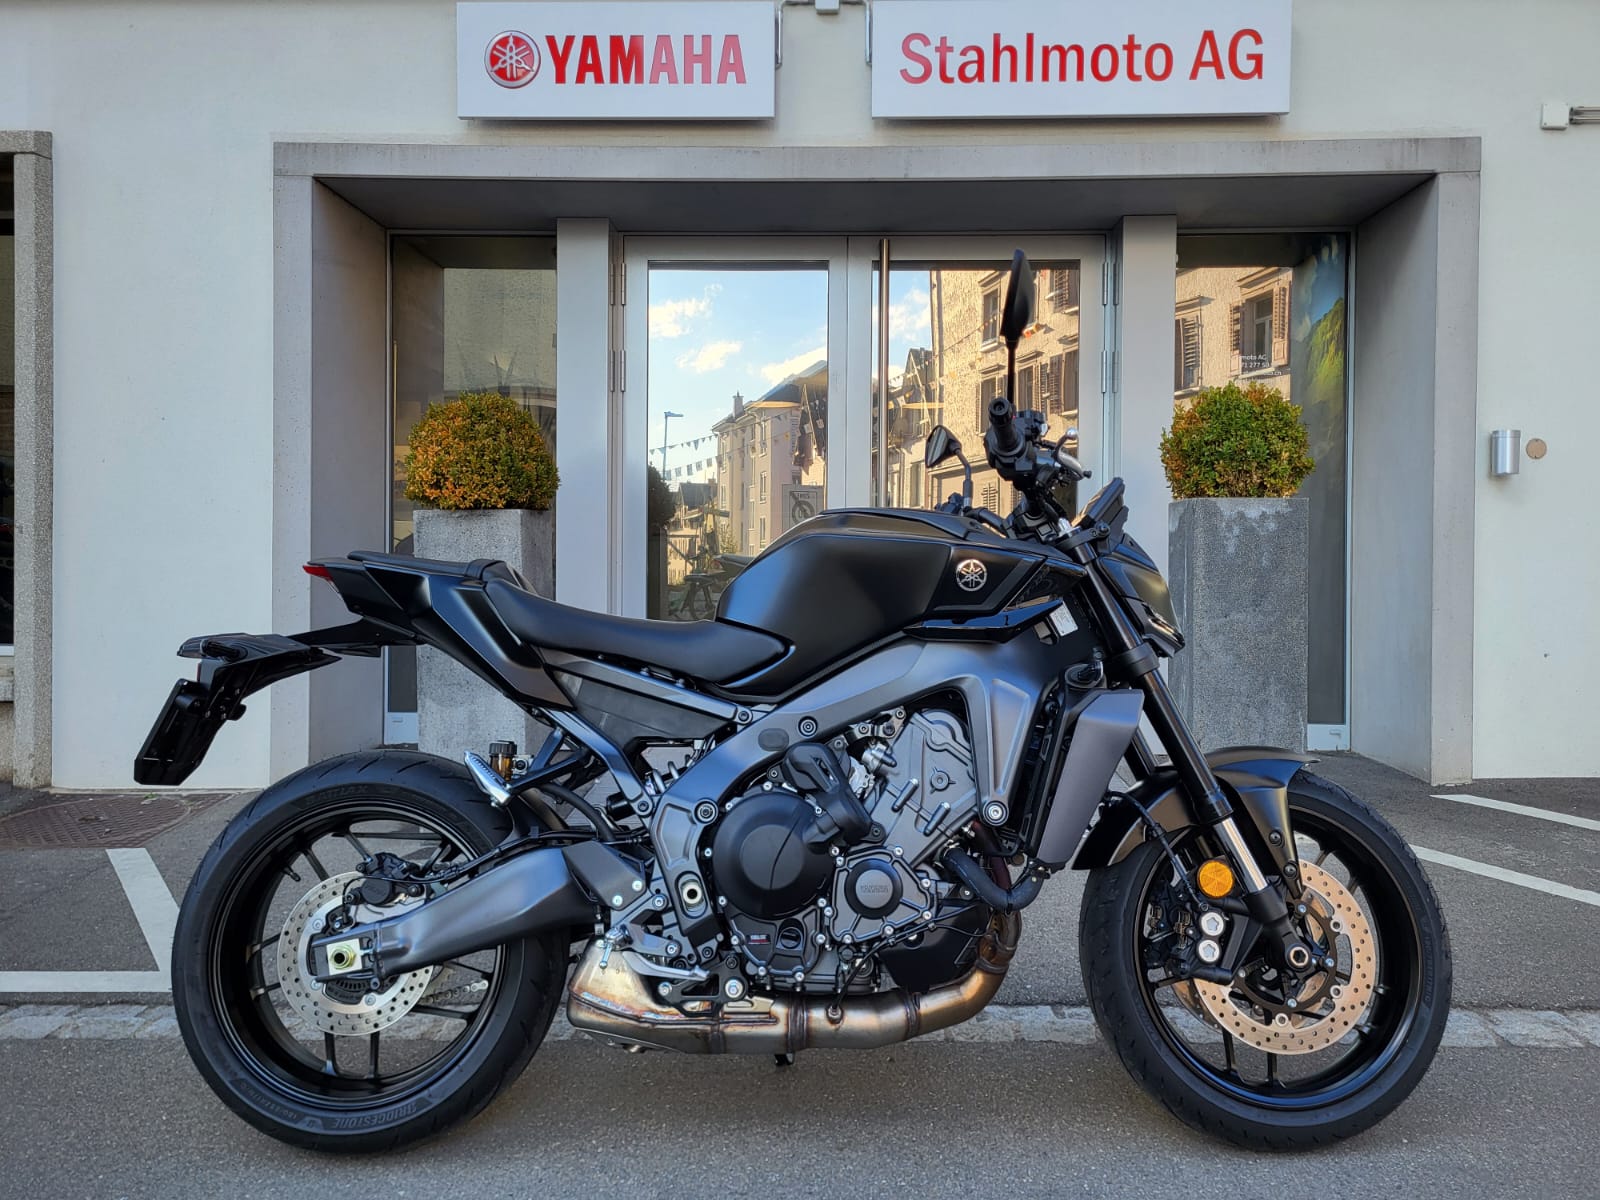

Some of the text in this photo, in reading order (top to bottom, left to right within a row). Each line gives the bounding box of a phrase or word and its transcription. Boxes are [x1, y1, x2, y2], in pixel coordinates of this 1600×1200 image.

[546, 35, 746, 85] YAMAHA
[900, 29, 1264, 85] Stahlmoto AG
[333, 1102, 417, 1129] BRIDGESTONE
